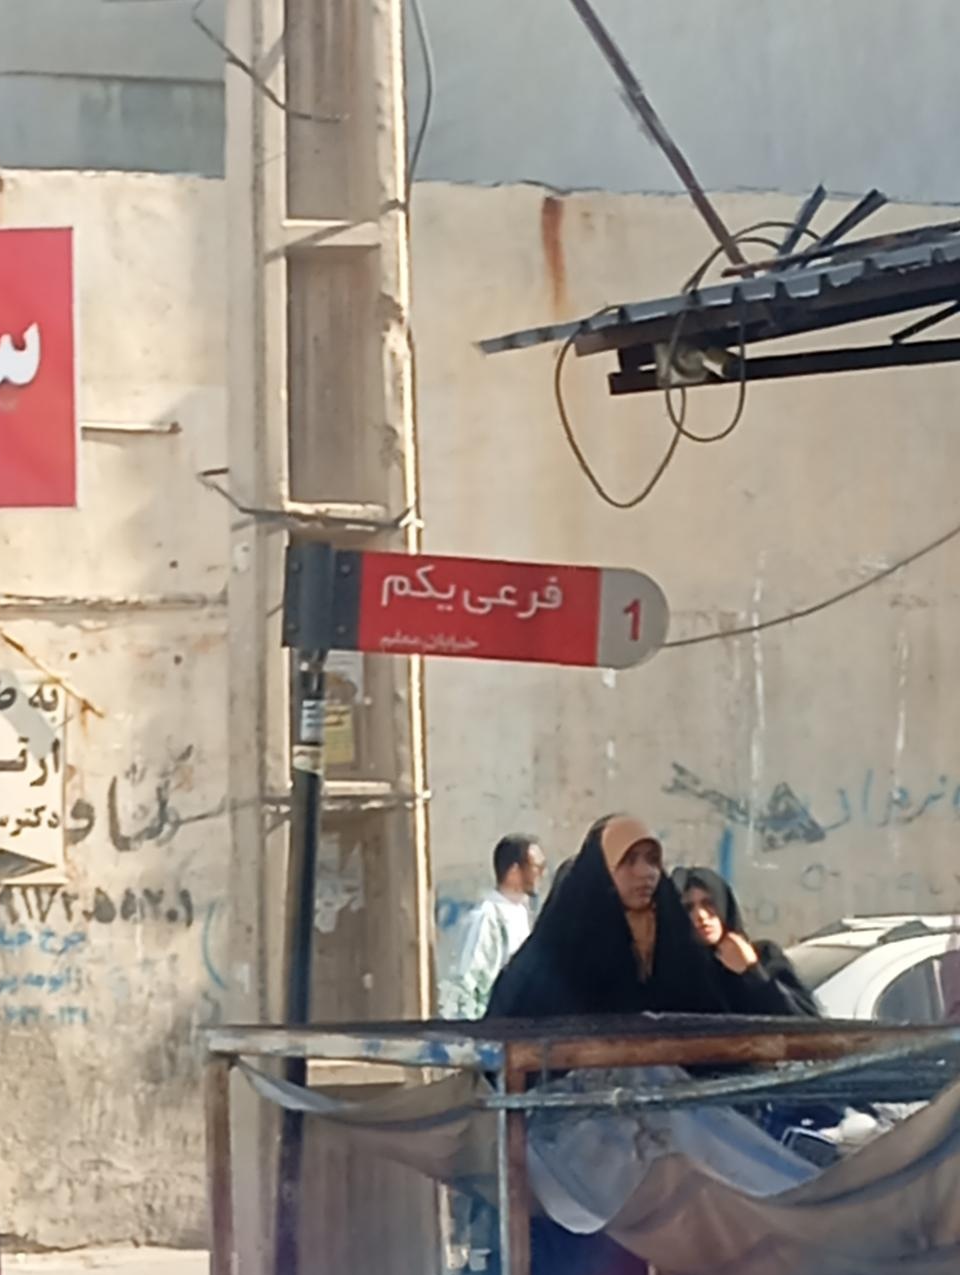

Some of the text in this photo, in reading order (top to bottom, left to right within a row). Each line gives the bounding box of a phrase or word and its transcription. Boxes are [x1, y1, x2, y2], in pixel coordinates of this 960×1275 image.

[381, 564, 563, 618] فرعی یکم
[622, 599, 641, 642] 1
[28, 684, 59, 722] به
[9, 804, 60, 837] دکتر
